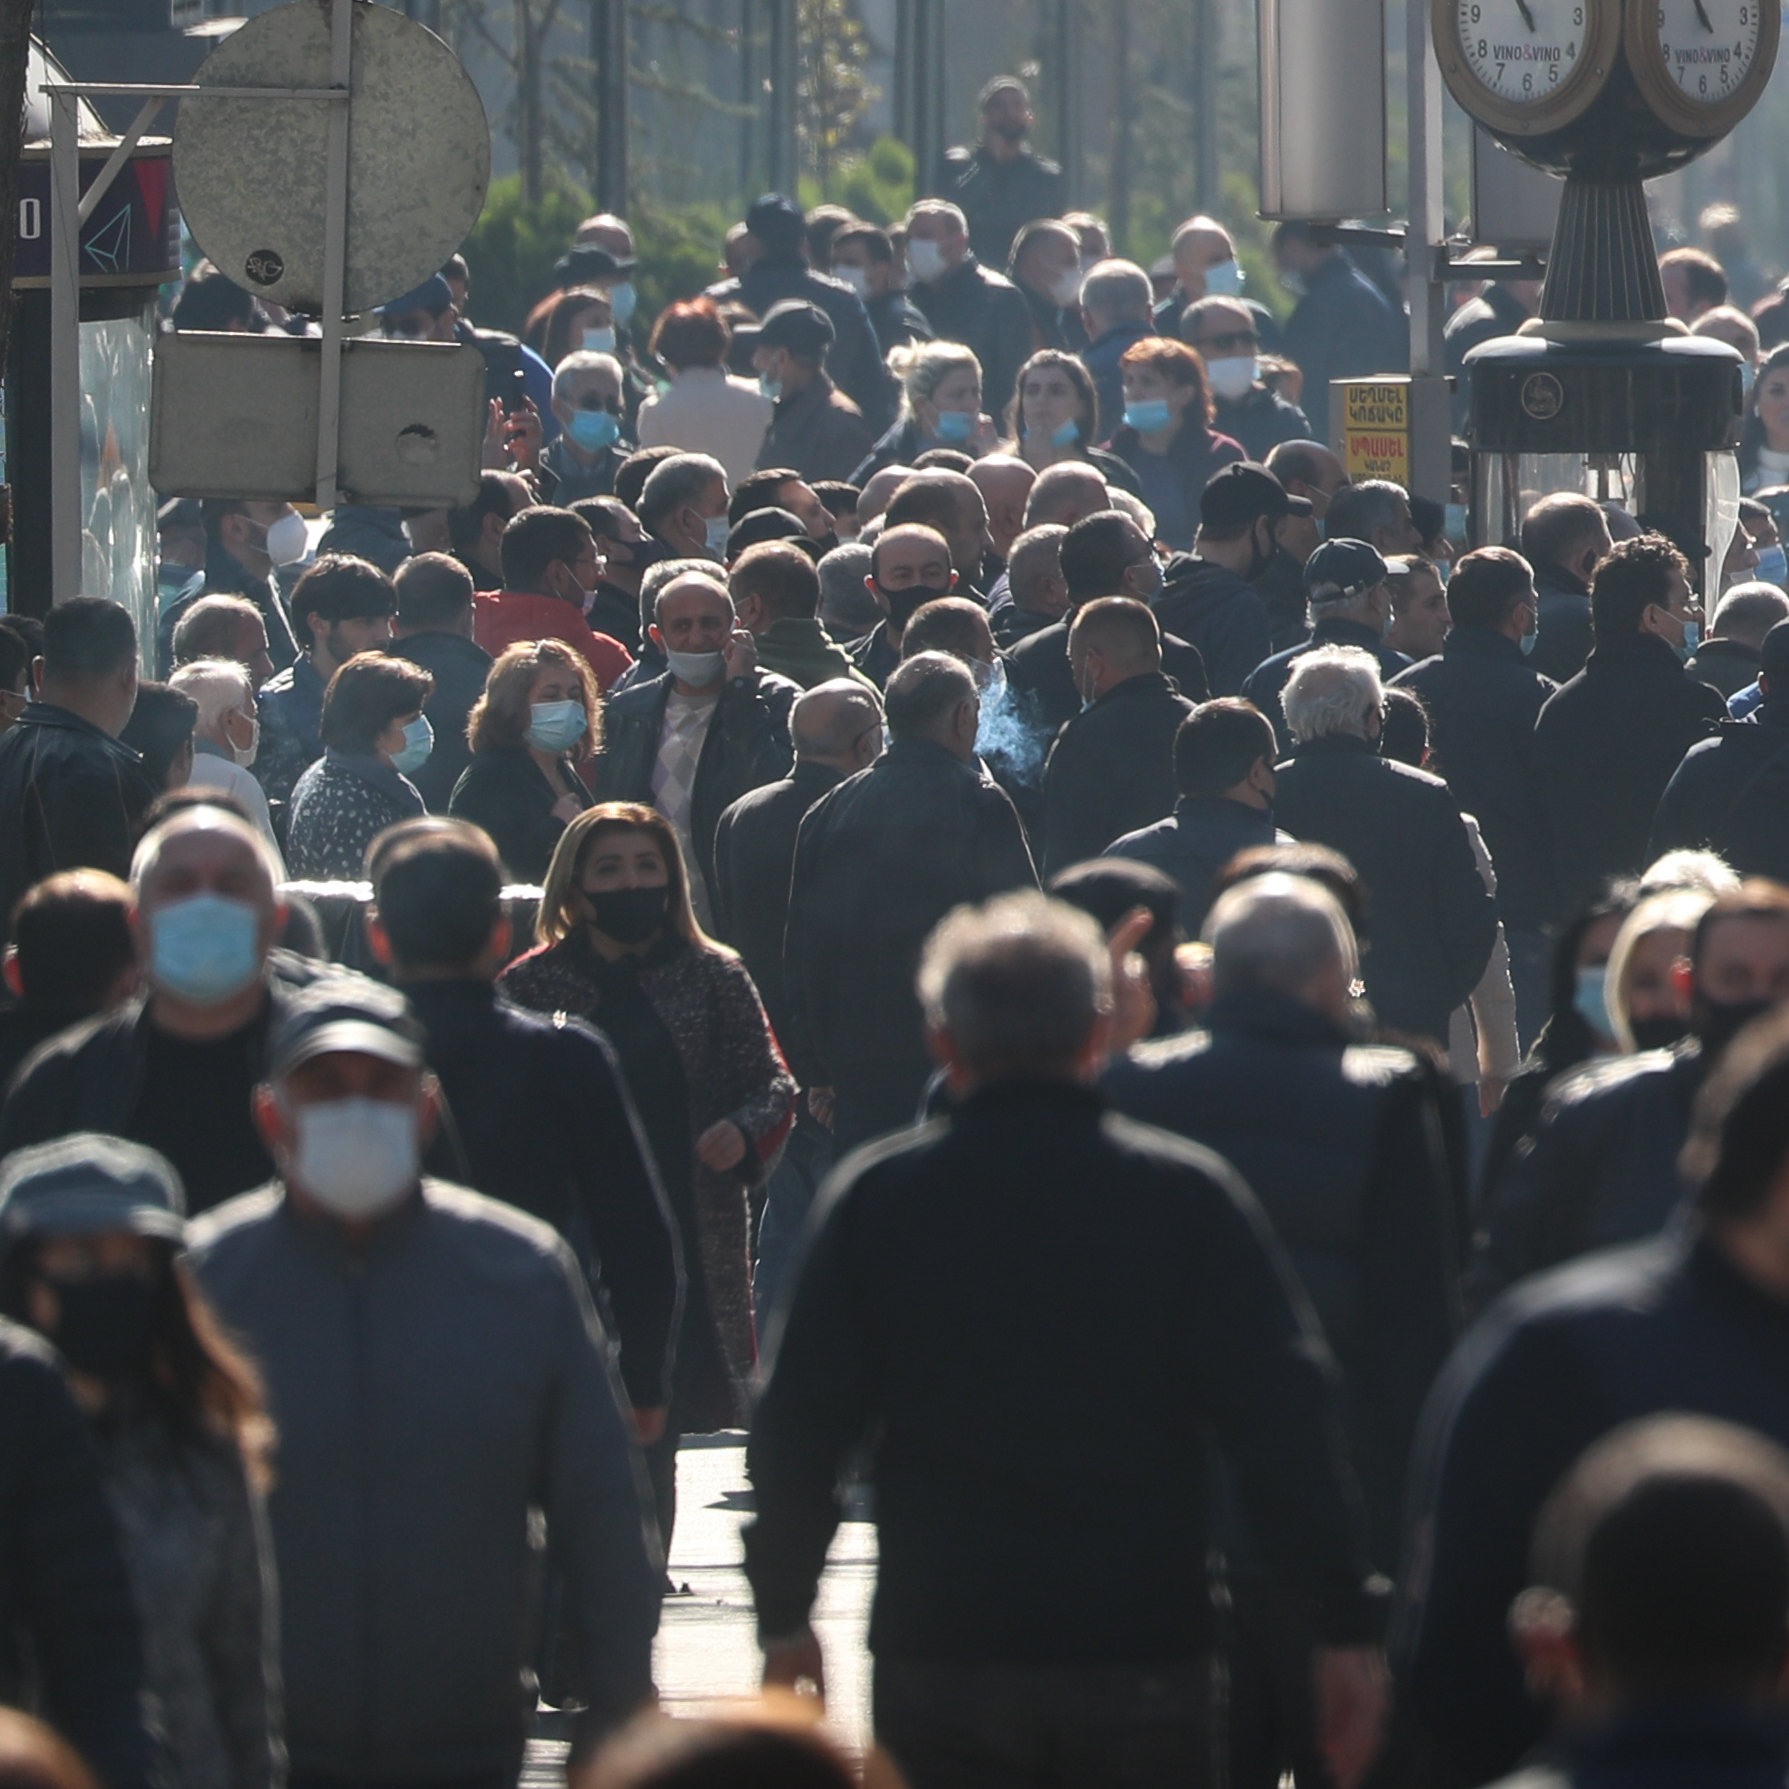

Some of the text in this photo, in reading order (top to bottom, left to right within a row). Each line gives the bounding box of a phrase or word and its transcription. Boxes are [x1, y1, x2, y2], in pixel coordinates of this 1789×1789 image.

[1470, 4, 1481, 24] 9
[1572, 6, 1583, 26] 3
[1739, 6, 1748, 26] 3
[1477, 39, 1488, 59] 8
[1493, 42, 1561, 62] VINO&VINO
[1565, 41, 1577, 60] 4
[1674, 45, 1731, 64] VINO&VINO
[1733, 40, 1743, 59] 4
[1495, 62, 1505, 81] 7
[1548, 63, 1558, 83] 5
[1676, 65, 1685, 84] 7
[1720, 64, 1729, 84] 5
[1522, 73, 1533, 92] 6
[1698, 73, 1708, 94] 6
